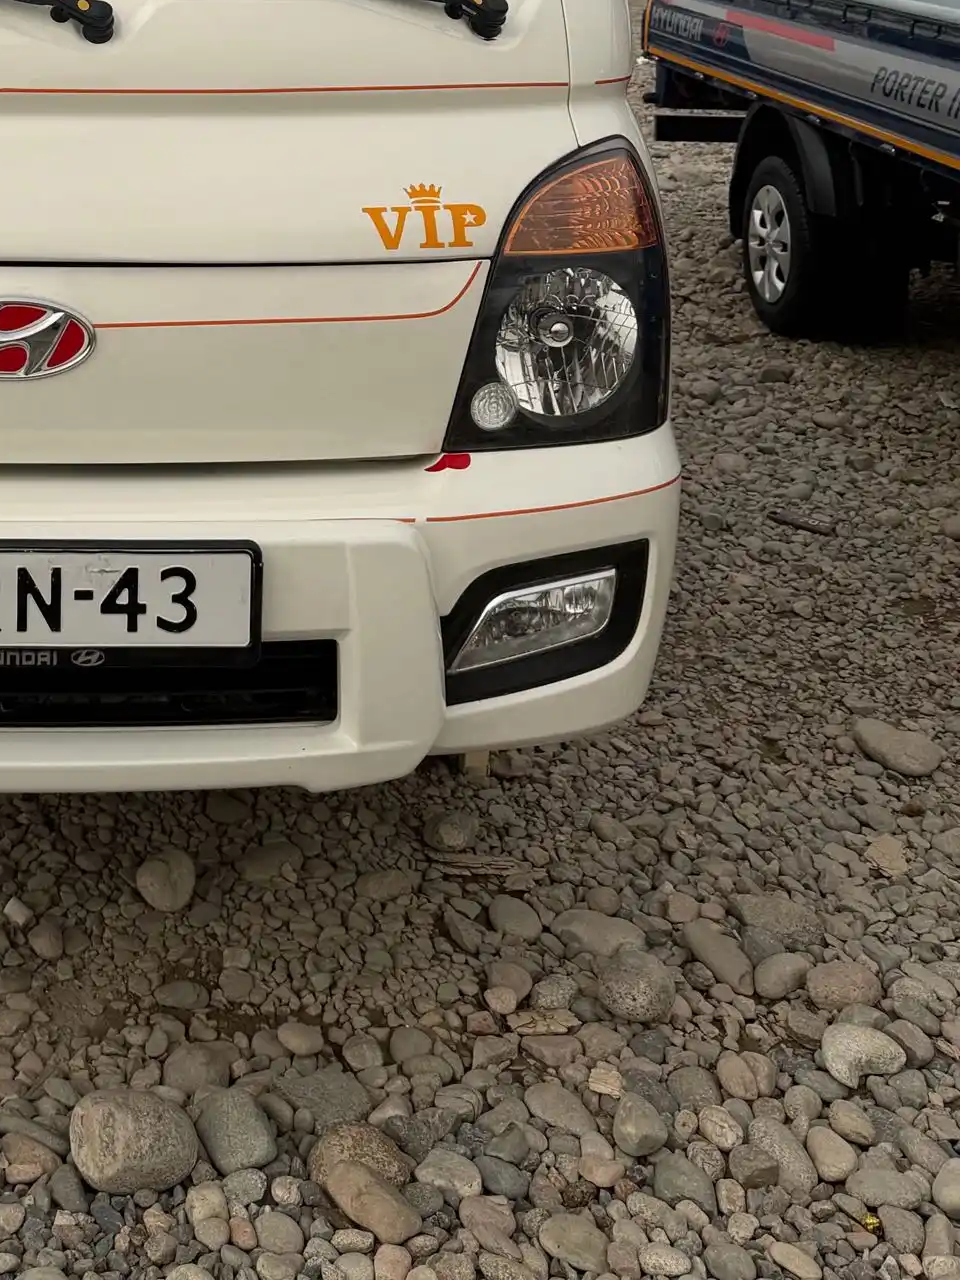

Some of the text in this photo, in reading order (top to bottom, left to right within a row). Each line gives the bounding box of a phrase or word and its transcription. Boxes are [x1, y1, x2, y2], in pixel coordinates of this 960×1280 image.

[651, 5, 703, 41] HYUNDAI
[870, 66, 948, 113] PORTER
[362, 204, 487, 250] VIP
